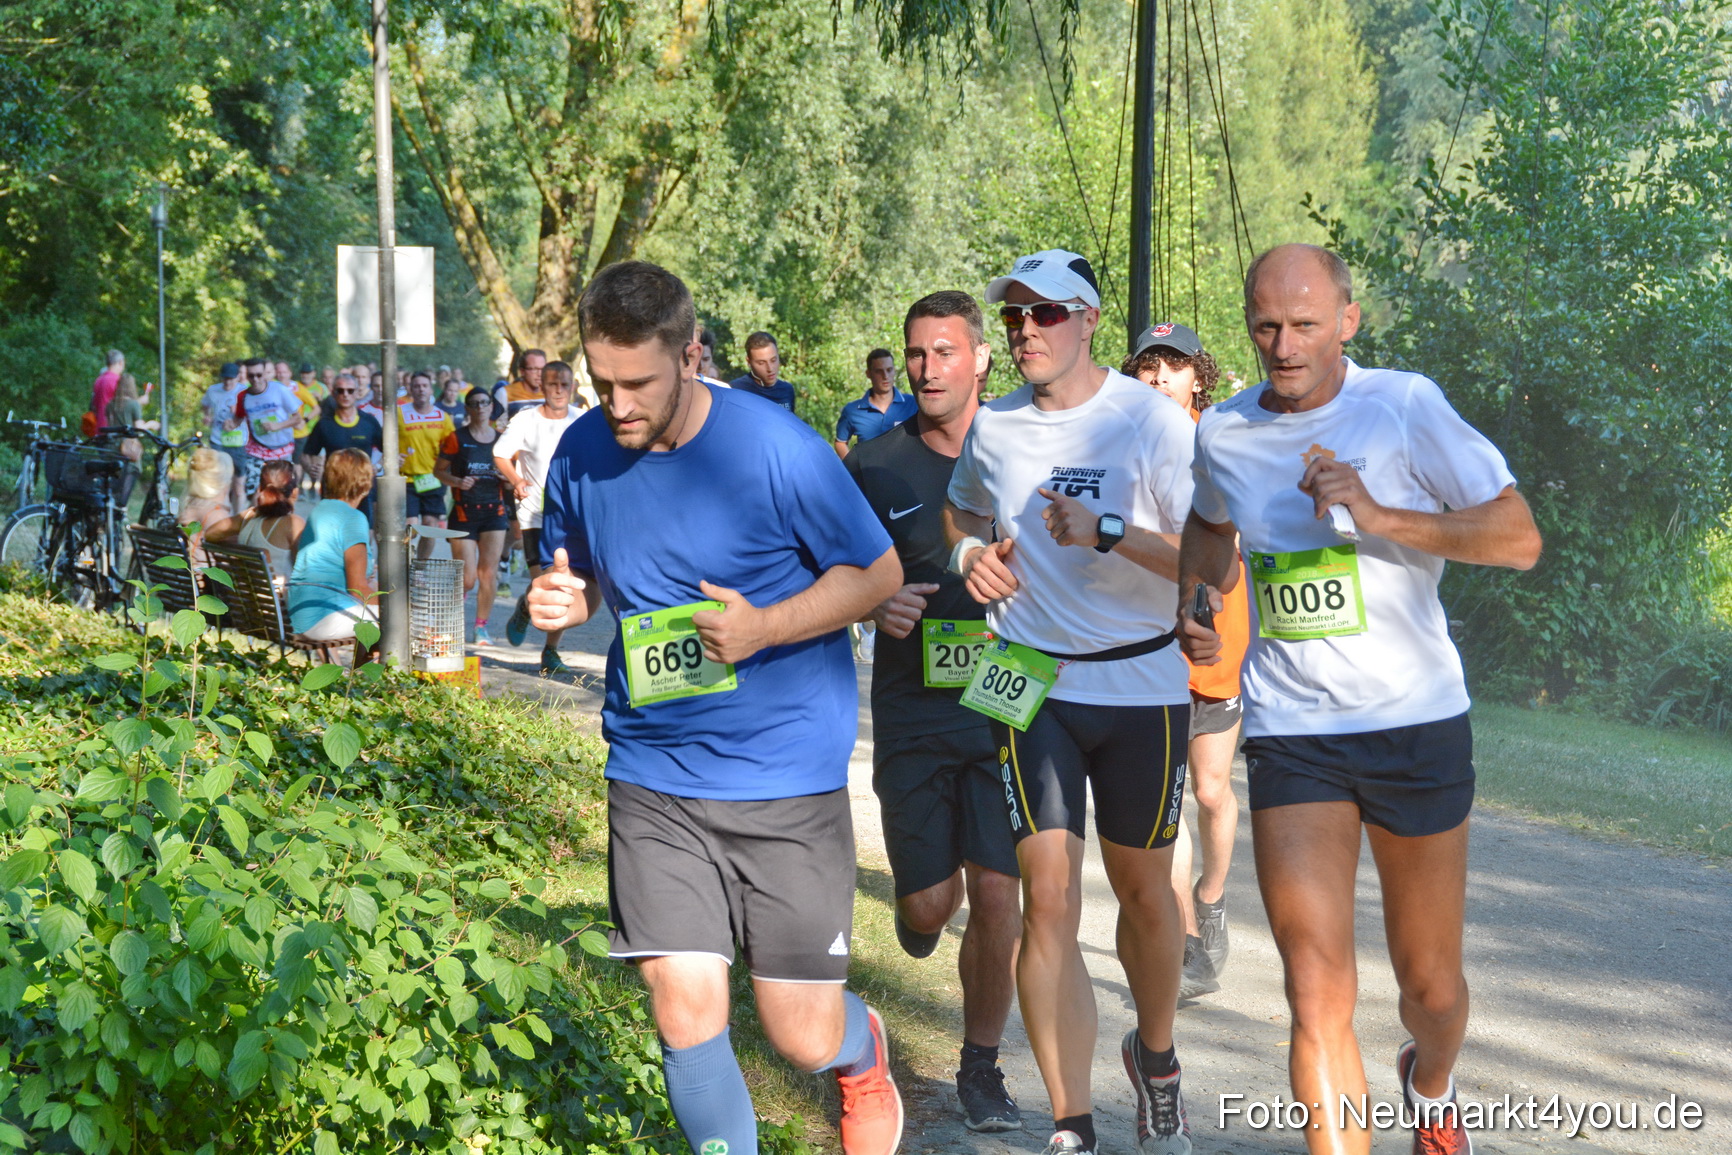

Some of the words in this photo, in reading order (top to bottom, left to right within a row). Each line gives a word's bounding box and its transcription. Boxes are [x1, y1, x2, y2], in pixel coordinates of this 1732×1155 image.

[1051, 466, 1106, 478] RUNNING
[1050, 477, 1100, 499] TGA
[1264, 579, 1345, 615] 1008
[1276, 616, 1297, 624] Rackl
[1299, 613, 1336, 623] Manfred
[645, 638, 703, 677] 669
[651, 675, 677, 687] Ascher
[679, 671, 702, 681] Peter
[948, 669, 969, 677] Bayer
[982, 664, 1027, 701] 809
[663, 682, 682, 691] Berger
[999, 698, 1022, 714] Thomas
[1001, 762, 1022, 831] SKINS
[1168, 763, 1185, 825] SKINS
